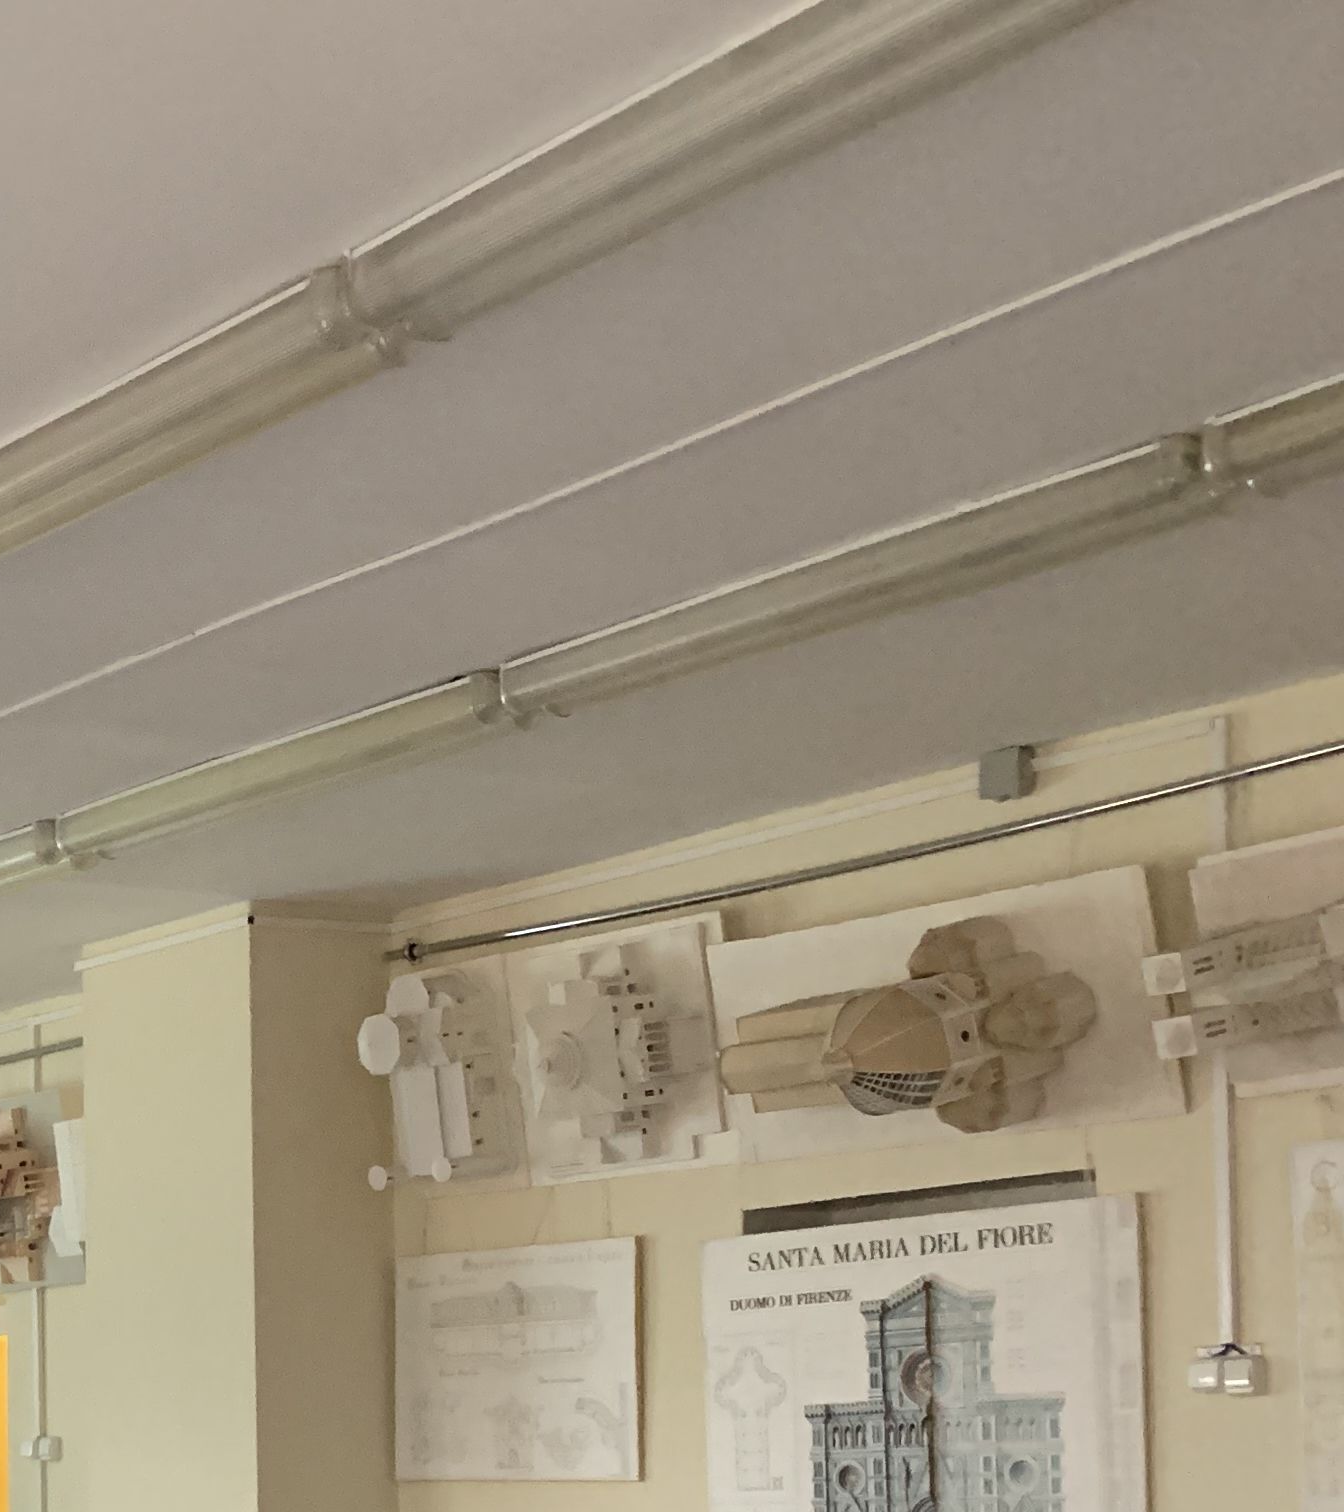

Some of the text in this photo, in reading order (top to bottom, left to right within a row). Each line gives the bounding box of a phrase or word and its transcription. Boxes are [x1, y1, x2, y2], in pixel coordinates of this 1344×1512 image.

[748, 1222, 1054, 1272] SANTA MARIA DEL FIORE
[730, 1289, 853, 1312] DUOMO DI FIRENZE
